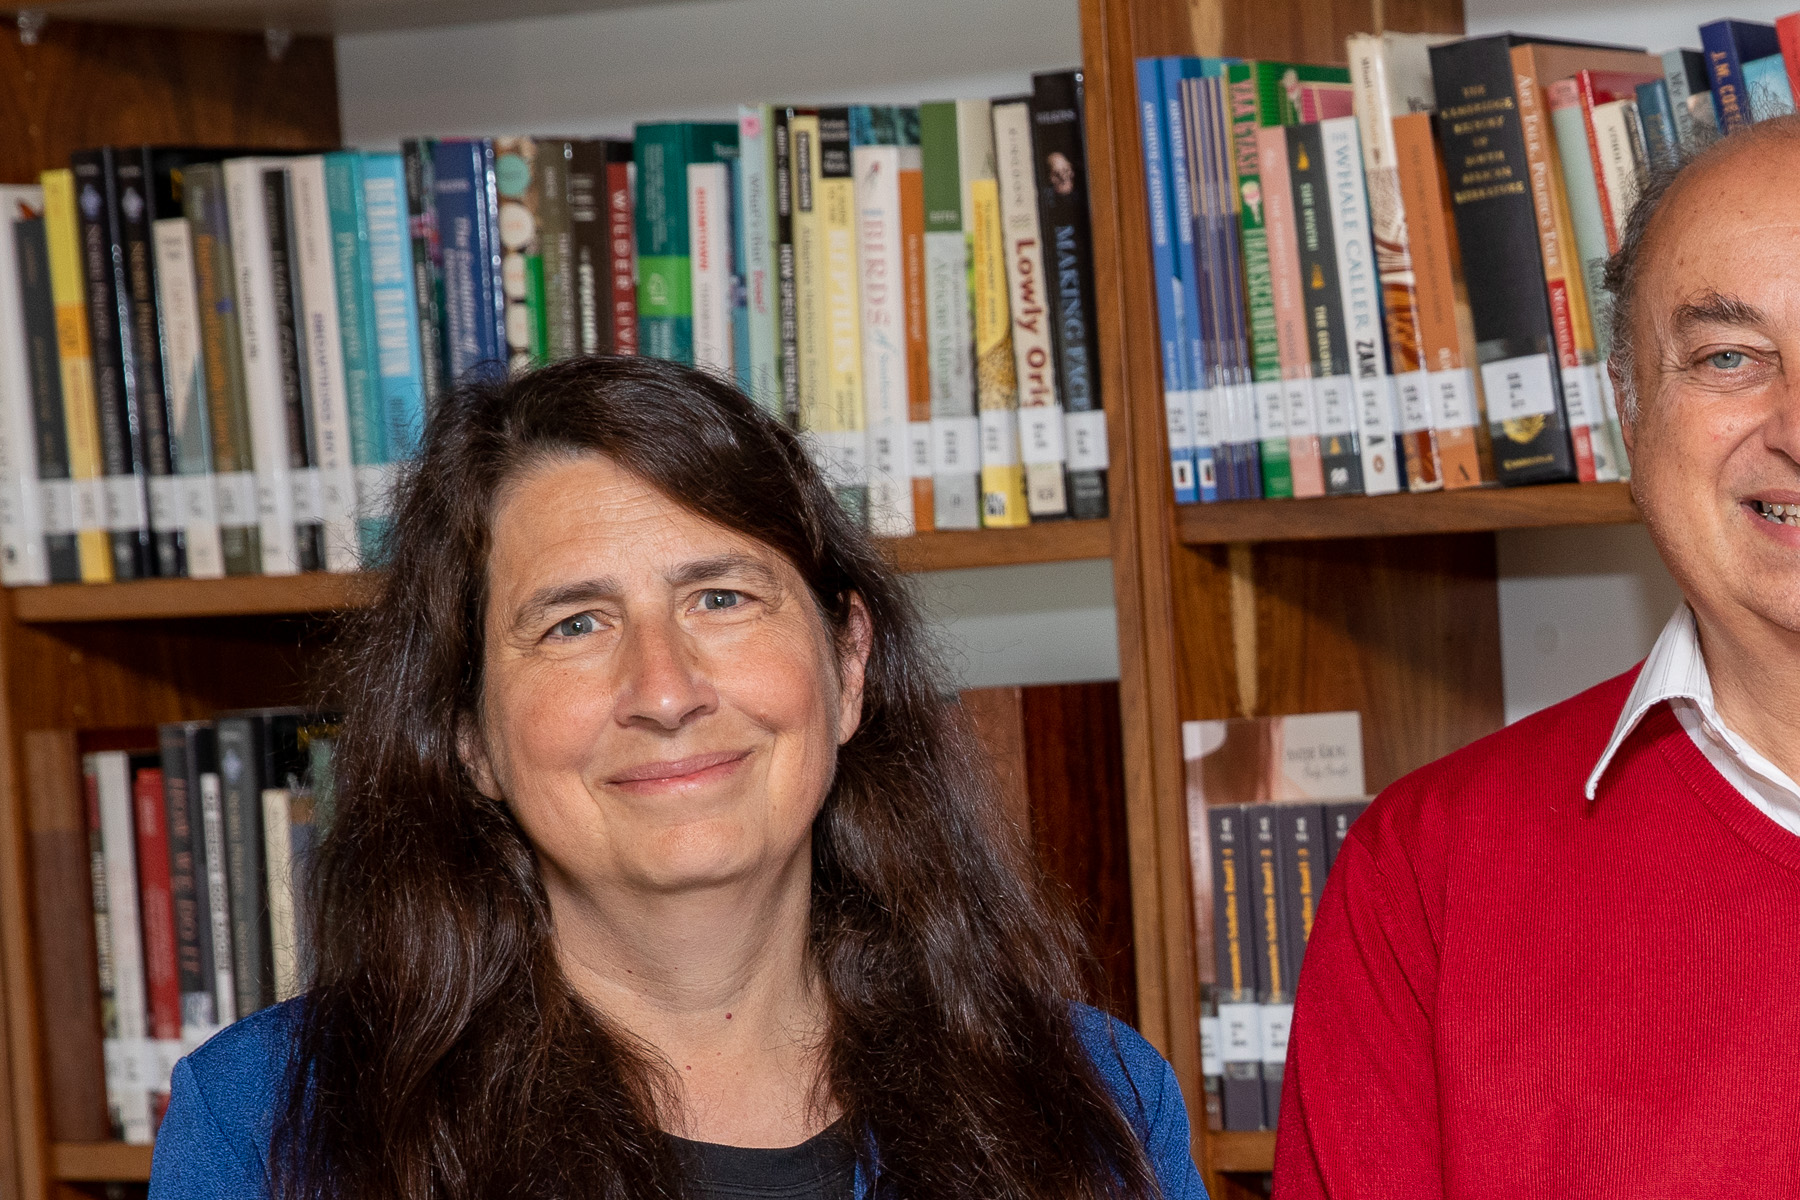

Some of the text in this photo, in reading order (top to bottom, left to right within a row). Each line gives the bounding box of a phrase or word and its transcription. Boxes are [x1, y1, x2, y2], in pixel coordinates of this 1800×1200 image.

[612, 189, 632, 290] WILDER
[1014, 237, 1046, 336] Lowly
[1055, 226, 1087, 341] MAKING
[1333, 145, 1371, 332] WHALE CALLER
